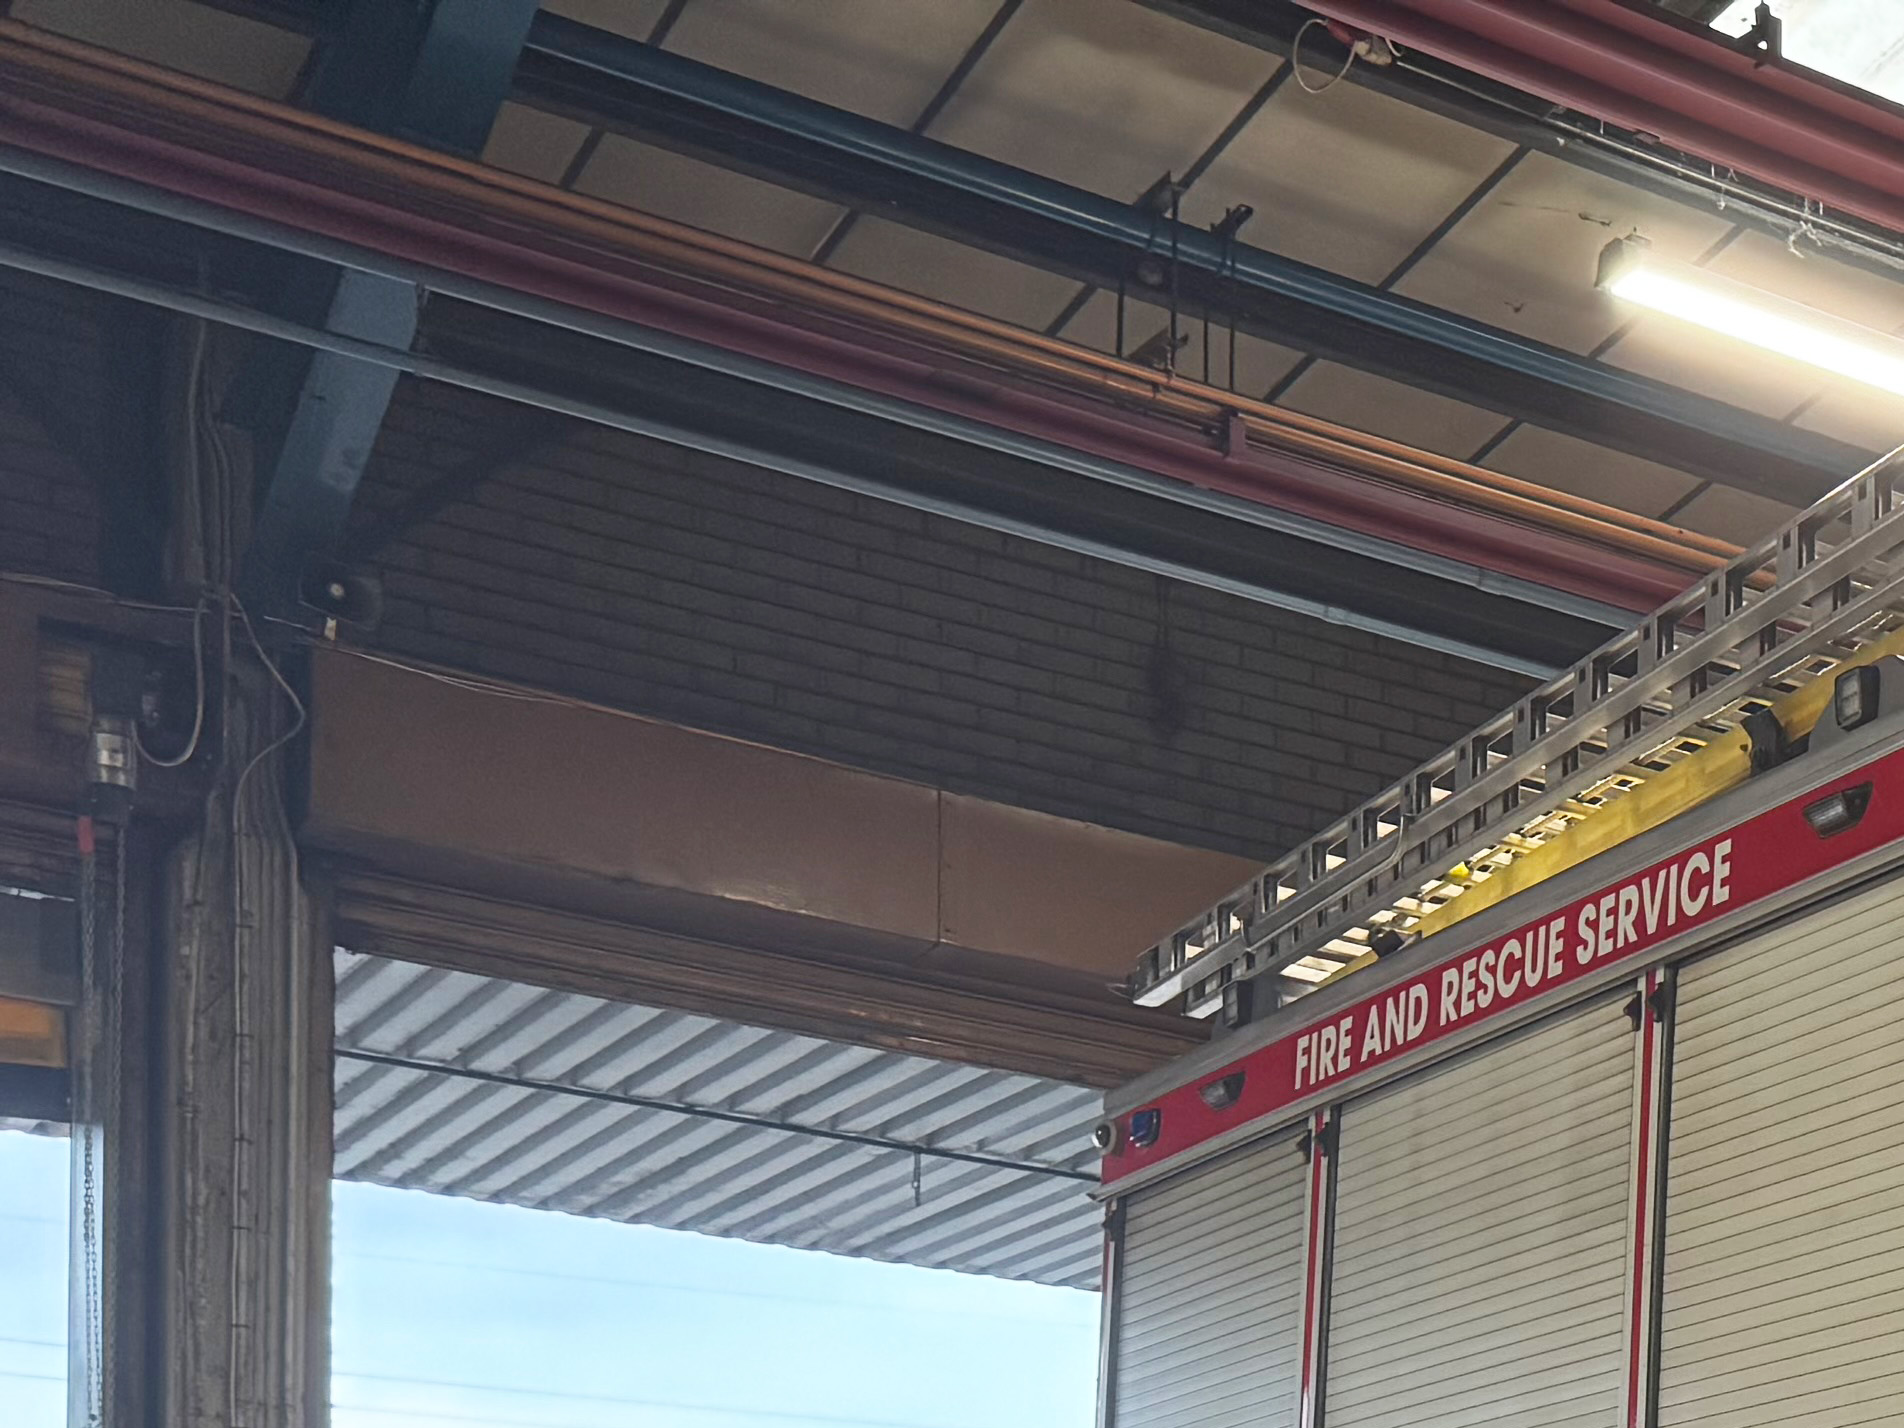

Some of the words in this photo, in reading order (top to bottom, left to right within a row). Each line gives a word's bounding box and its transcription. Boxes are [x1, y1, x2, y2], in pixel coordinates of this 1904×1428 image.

[1294, 1022, 1352, 1091] FIRE
[1362, 991, 1428, 1062] AND
[1439, 916, 1566, 1026] RESCUE
[1576, 839, 1732, 966] SERVICE
